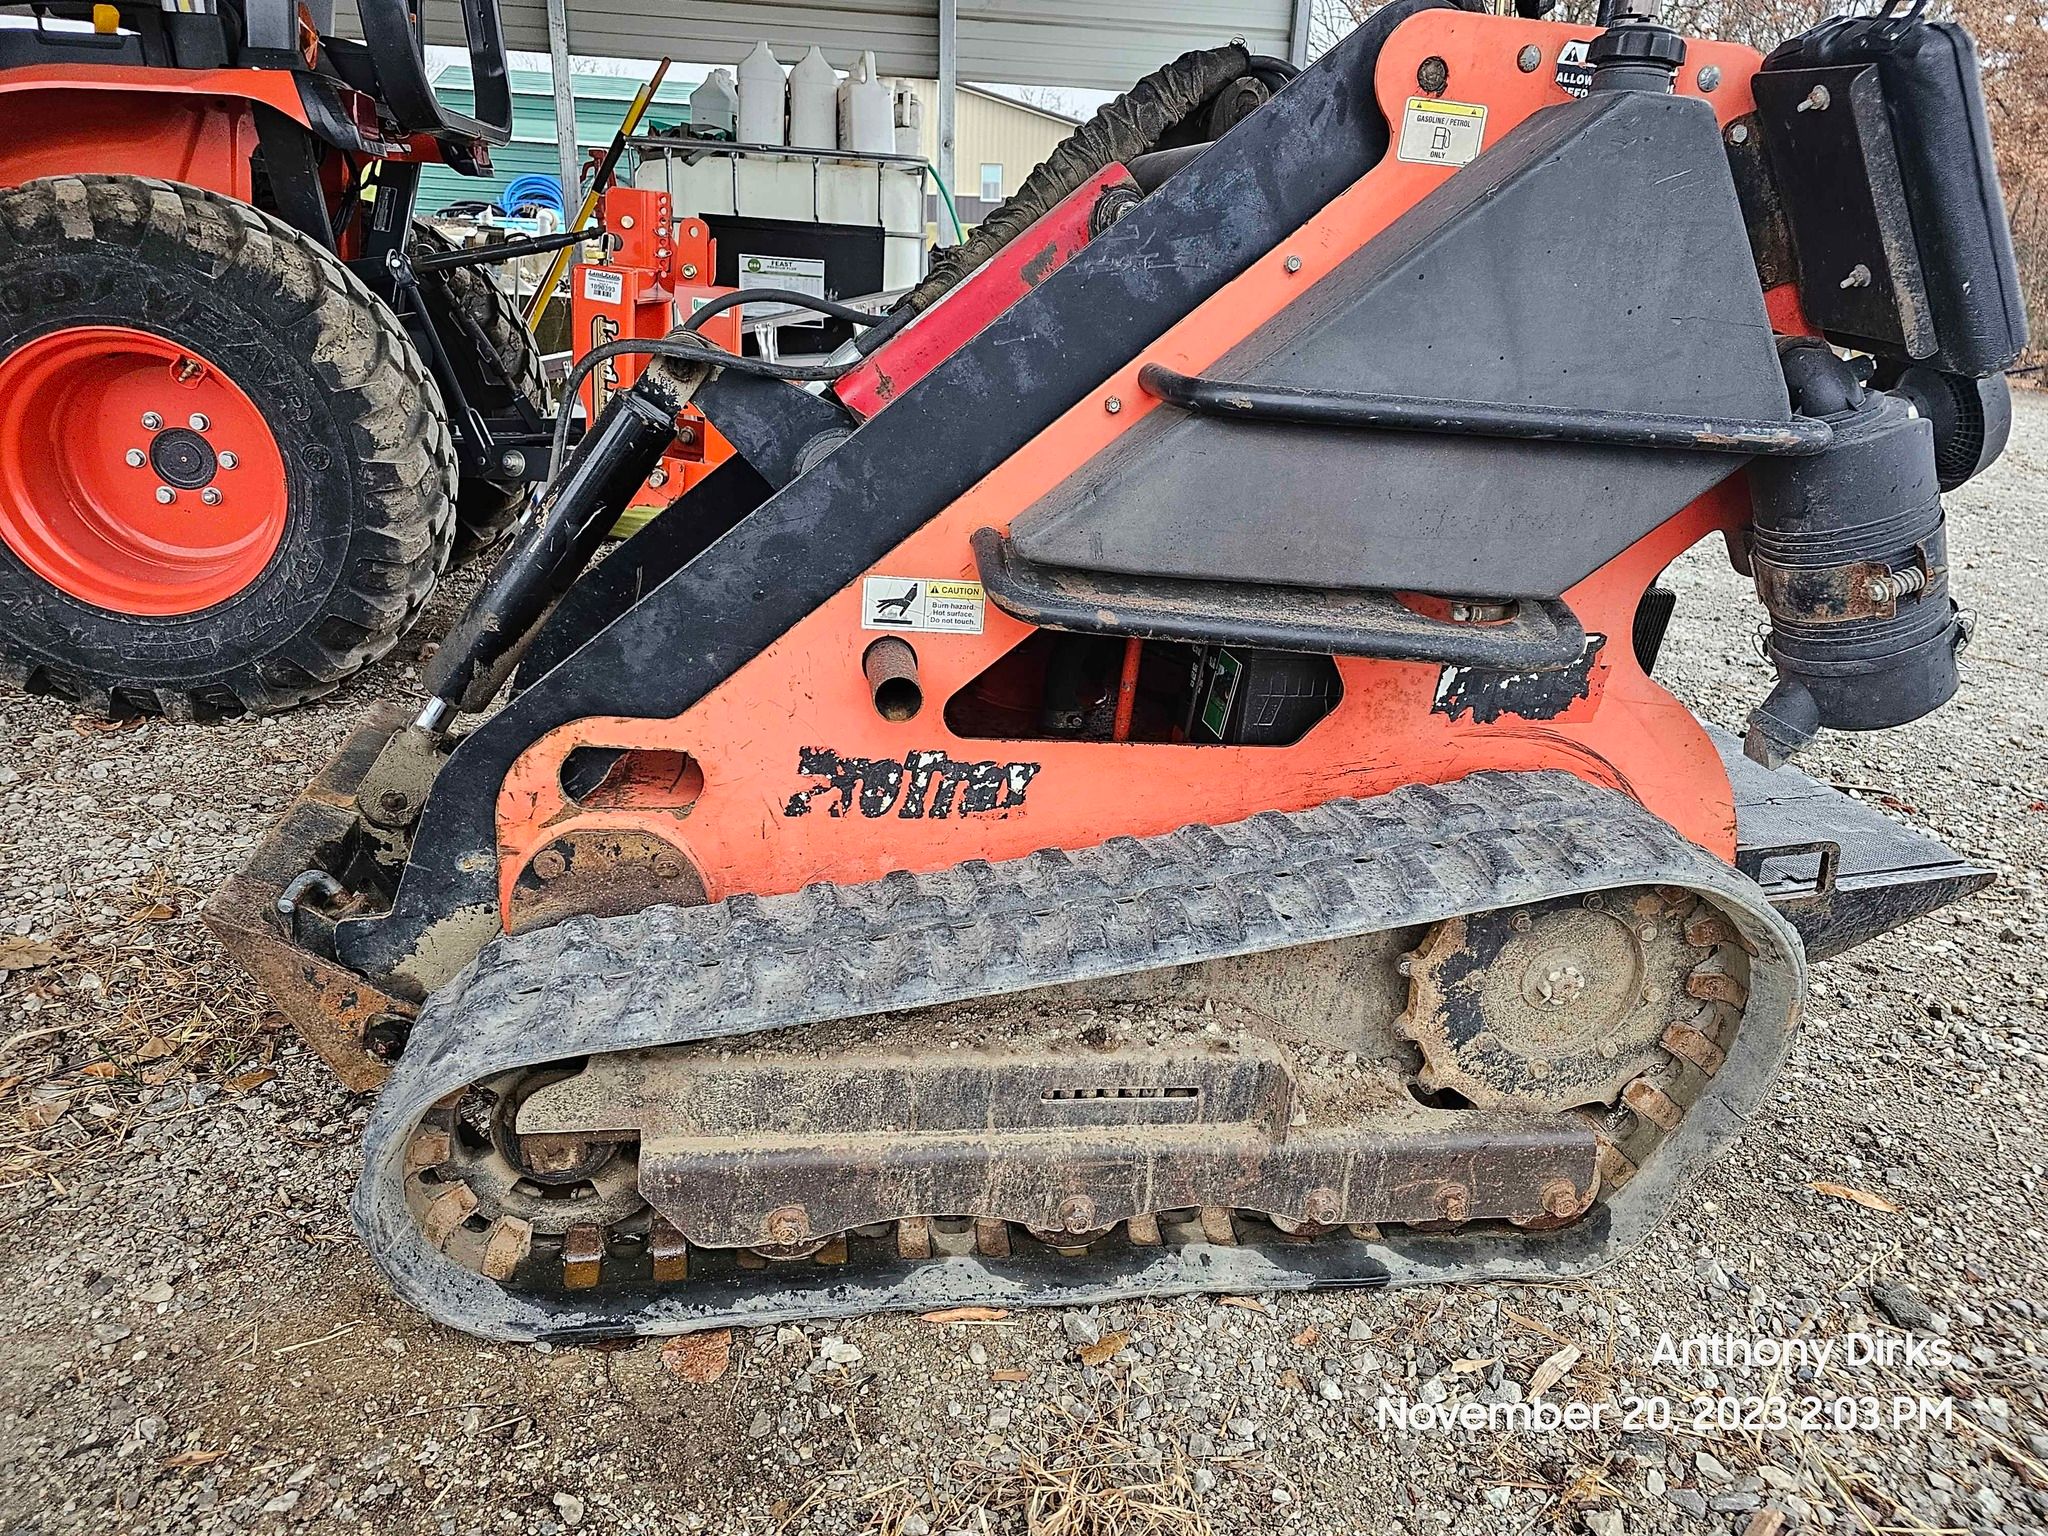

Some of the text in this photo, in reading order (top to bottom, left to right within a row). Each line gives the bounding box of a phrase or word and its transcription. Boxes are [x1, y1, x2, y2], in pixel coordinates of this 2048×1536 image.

[1416, 114, 1445, 125] GASOLINE
[1449, 118, 1471, 128] PETROL
[1430, 151, 1446, 159] ONLY
[771, 260, 792, 268] FEAST
[941, 586, 980, 596] CAUTION
[932, 601, 976, 611] Burn hazard.
[954, 618, 976, 626] touch.
